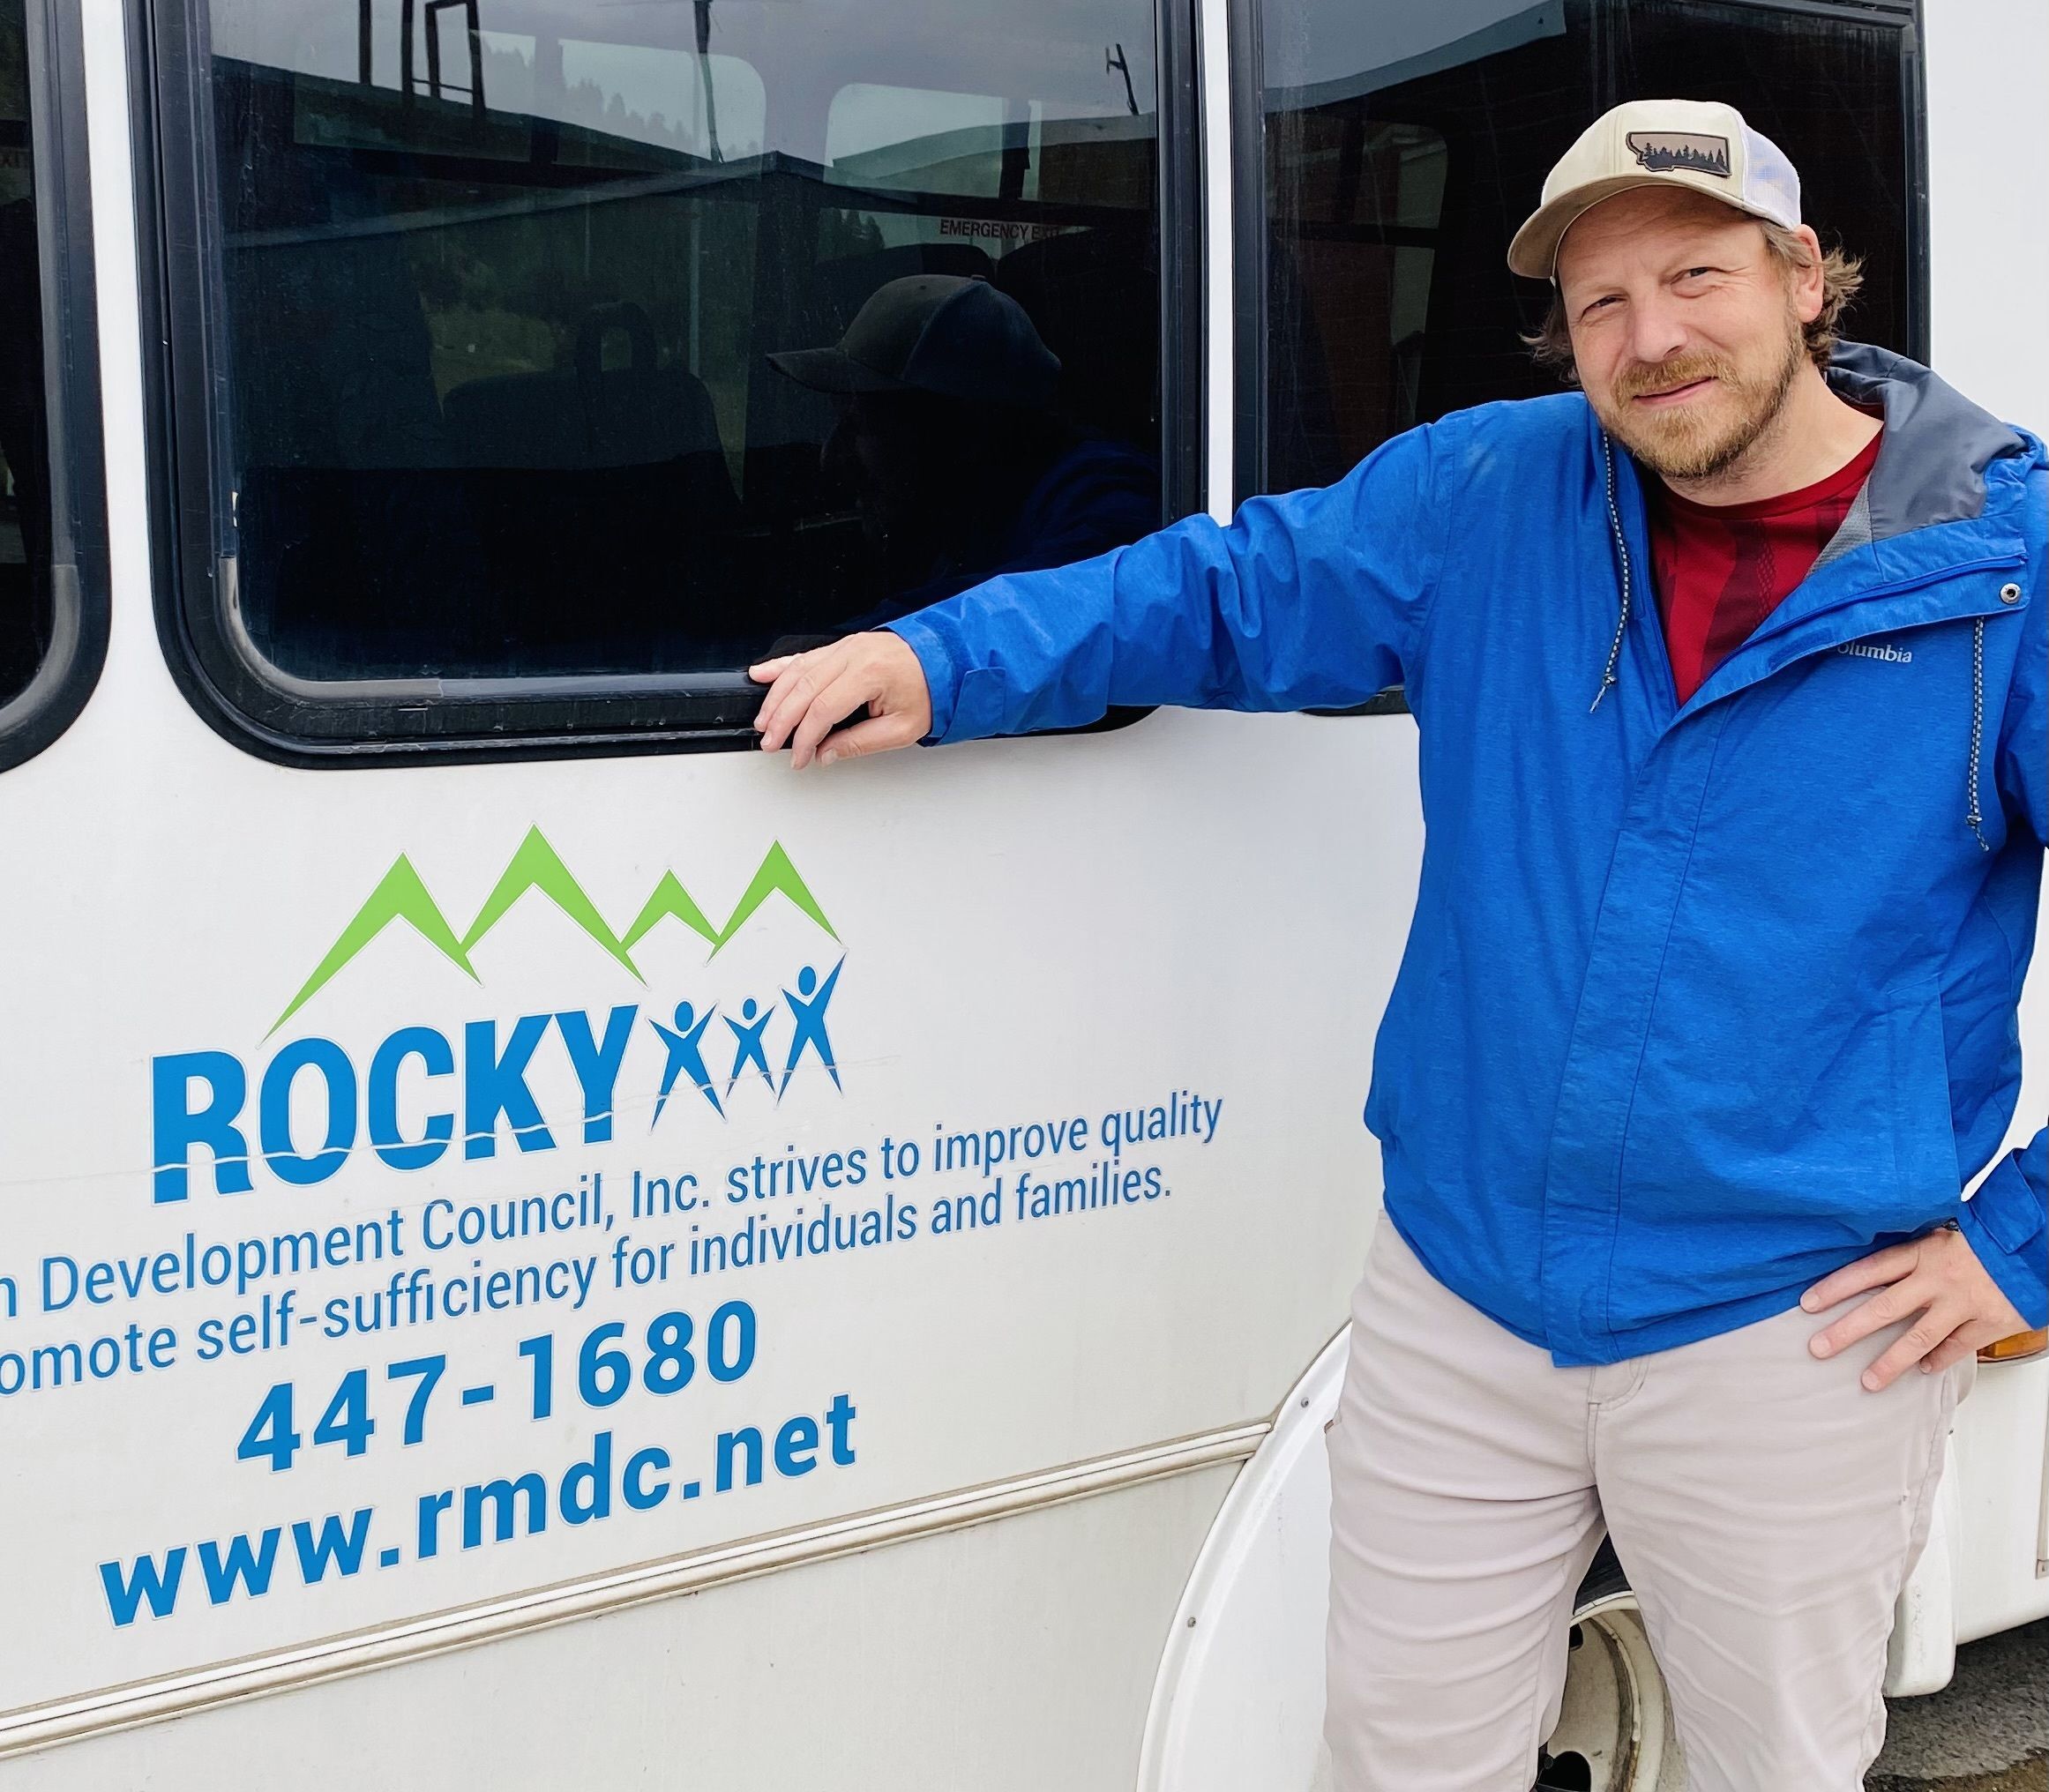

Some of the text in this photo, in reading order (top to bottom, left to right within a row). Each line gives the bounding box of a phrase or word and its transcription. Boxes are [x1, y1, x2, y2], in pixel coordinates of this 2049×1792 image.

[939, 218, 1029, 240] EMERGENCY
[1836, 640, 1913, 663] olumbia
[42, 1208, 404, 1313] Development
[422, 1172, 615, 1251] Council,
[631, 1170, 709, 1219] Inc.
[728, 1144, 867, 1205] strives
[880, 1137, 922, 1180] to
[934, 1117, 1088, 1177] improve
[1100, 1090, 1223, 1158] quality
[151, 1004, 639, 1205] ROCKY
[197, 1256, 597, 1363] self-sufficiency
[610, 1236, 674, 1288] for
[690, 1195, 918, 1276] individuals
[931, 1177, 1003, 1236] and
[1016, 1160, 1171, 1221] families.
[236, 1299, 759, 1473] 447-1680
[99, 1393, 857, 1628] www.rmdc.net
